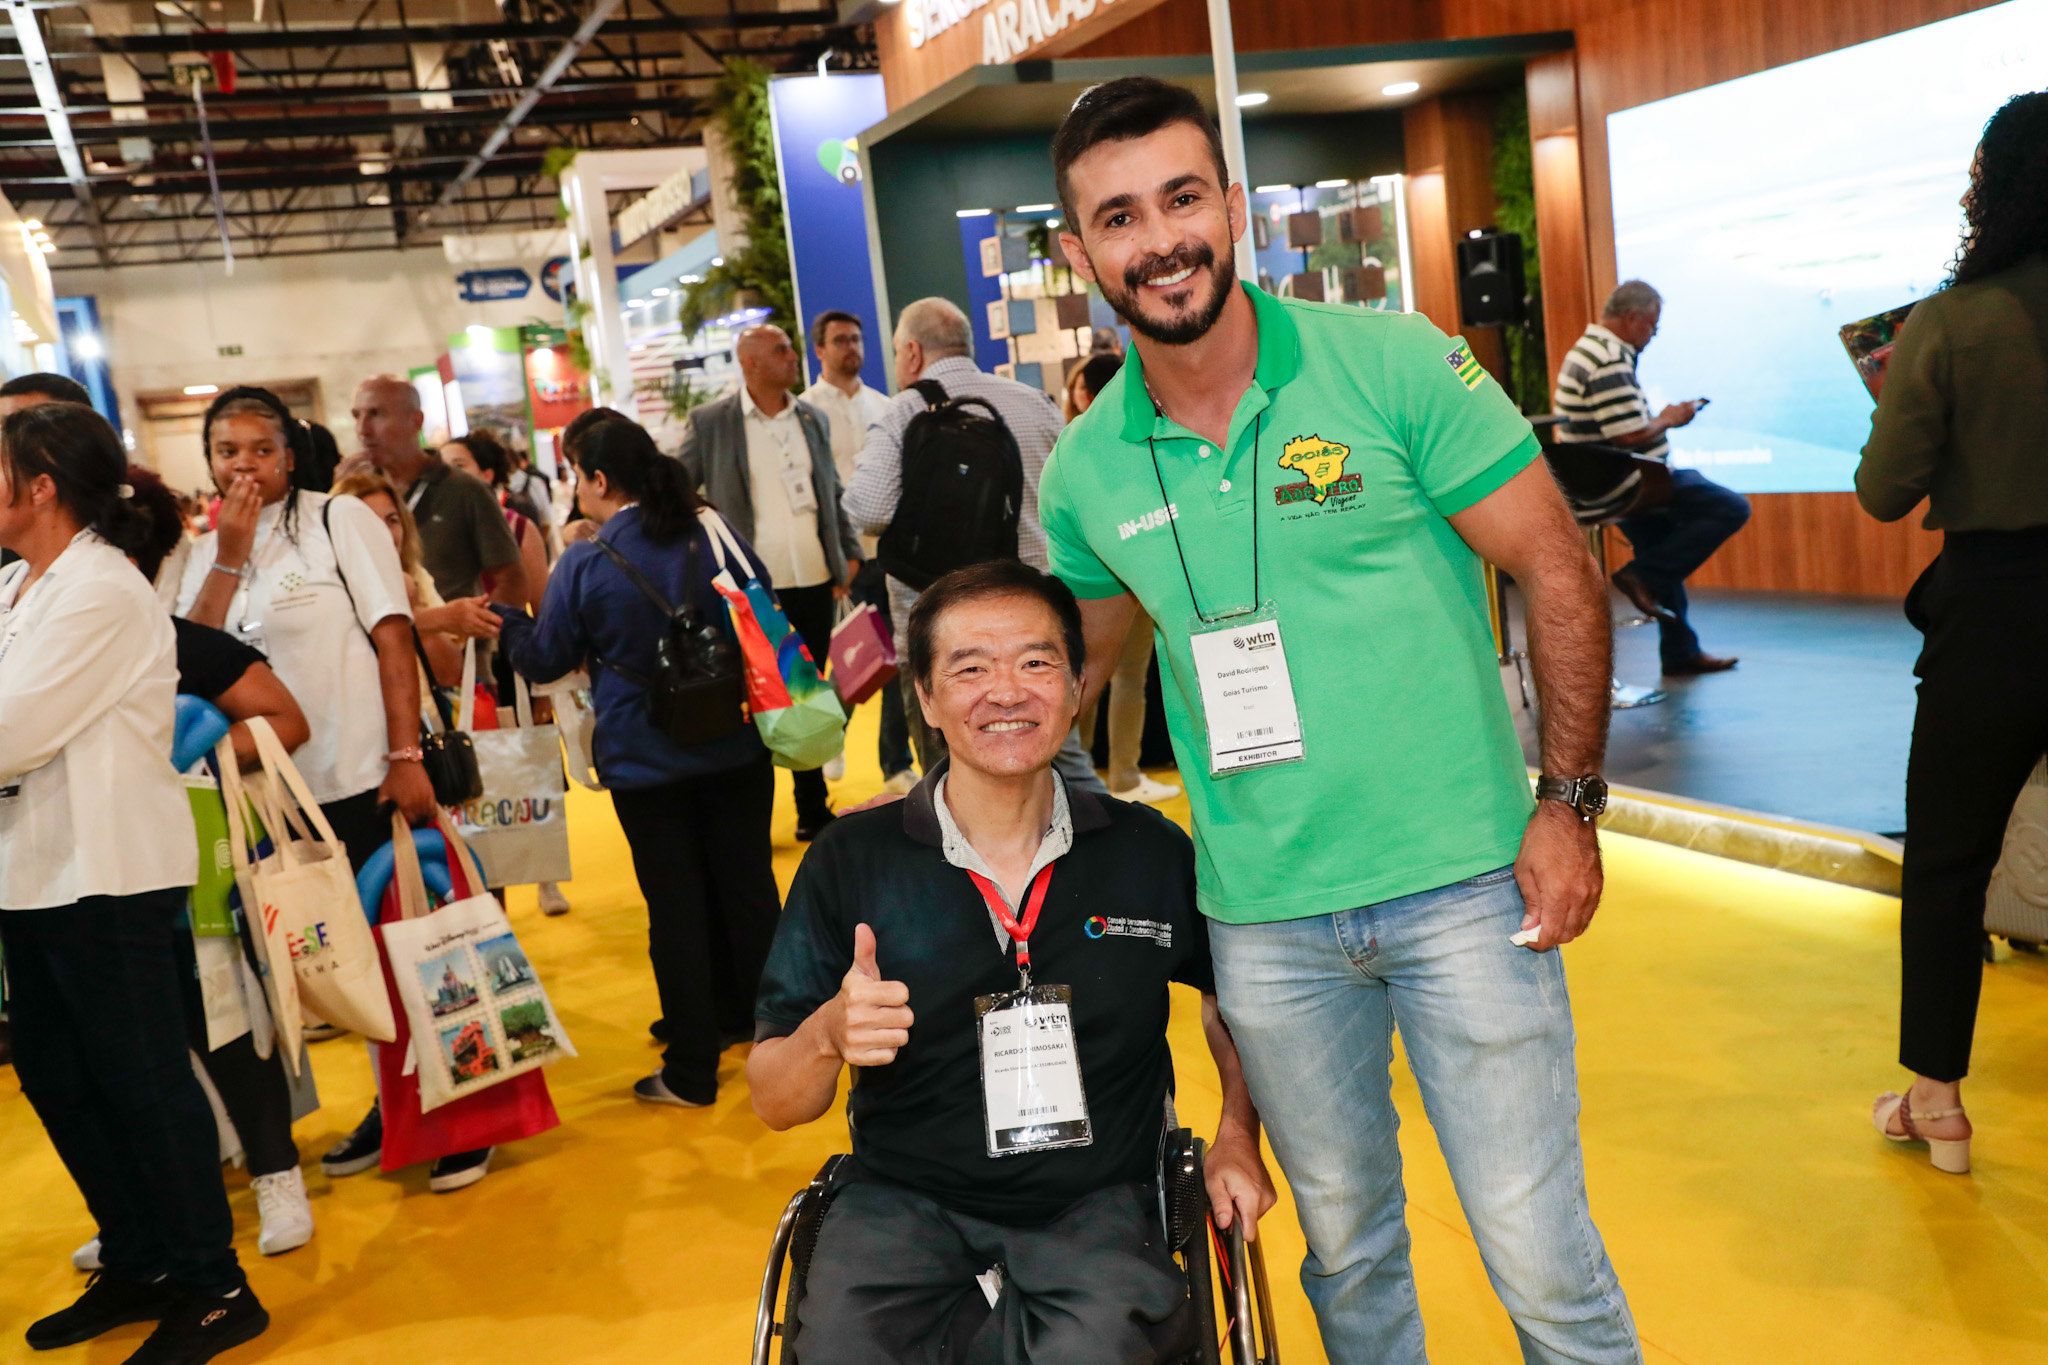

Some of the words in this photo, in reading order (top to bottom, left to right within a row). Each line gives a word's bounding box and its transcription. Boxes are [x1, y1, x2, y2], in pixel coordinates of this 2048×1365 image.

[1281, 479, 1359, 502] ADENTRO
[1340, 503, 1367, 512] REPLAY
[1117, 503, 1179, 540] IN-USE
[1246, 631, 1275, 645] wtm
[1217, 670, 1236, 679] David
[1236, 664, 1270, 675] Rodrigues
[1242, 684, 1268, 694] Turismo
[1238, 750, 1278, 762] EXHIBITOR
[1039, 1013, 1067, 1025] wtm
[994, 1048, 1024, 1058] RICARDO
